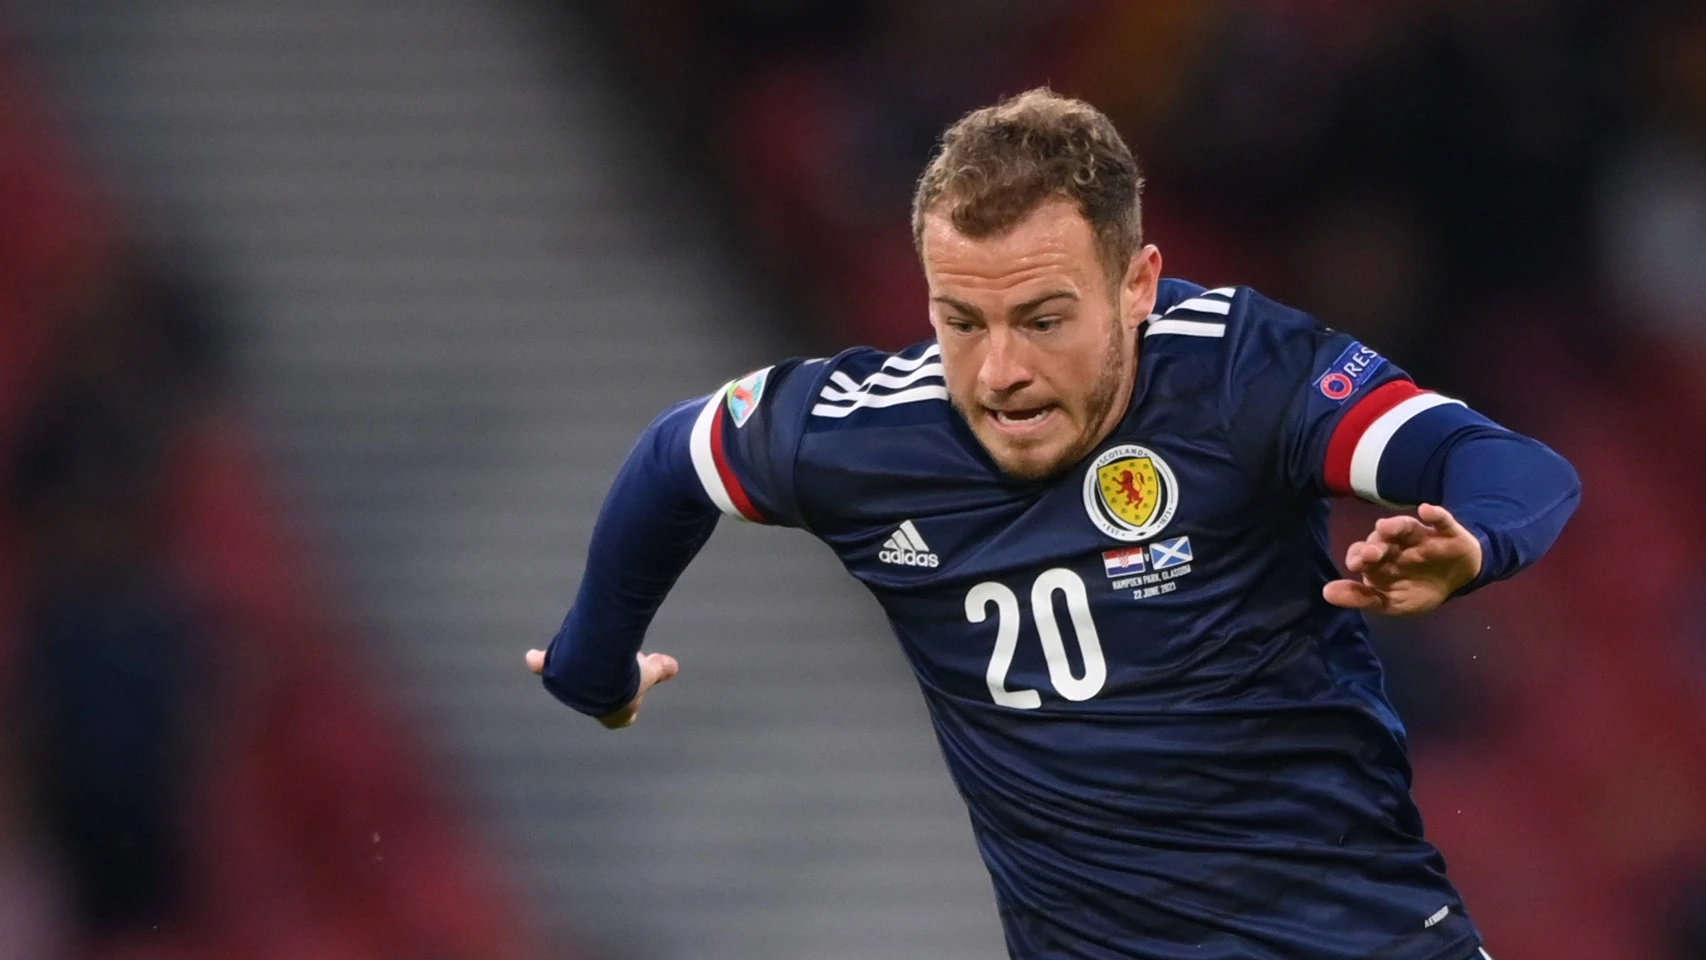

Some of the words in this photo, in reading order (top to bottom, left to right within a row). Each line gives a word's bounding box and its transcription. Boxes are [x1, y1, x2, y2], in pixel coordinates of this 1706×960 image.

[1099, 448, 1144, 465] SCOTLAND
[878, 549, 939, 568] adidas
[964, 567, 1107, 710] 20
